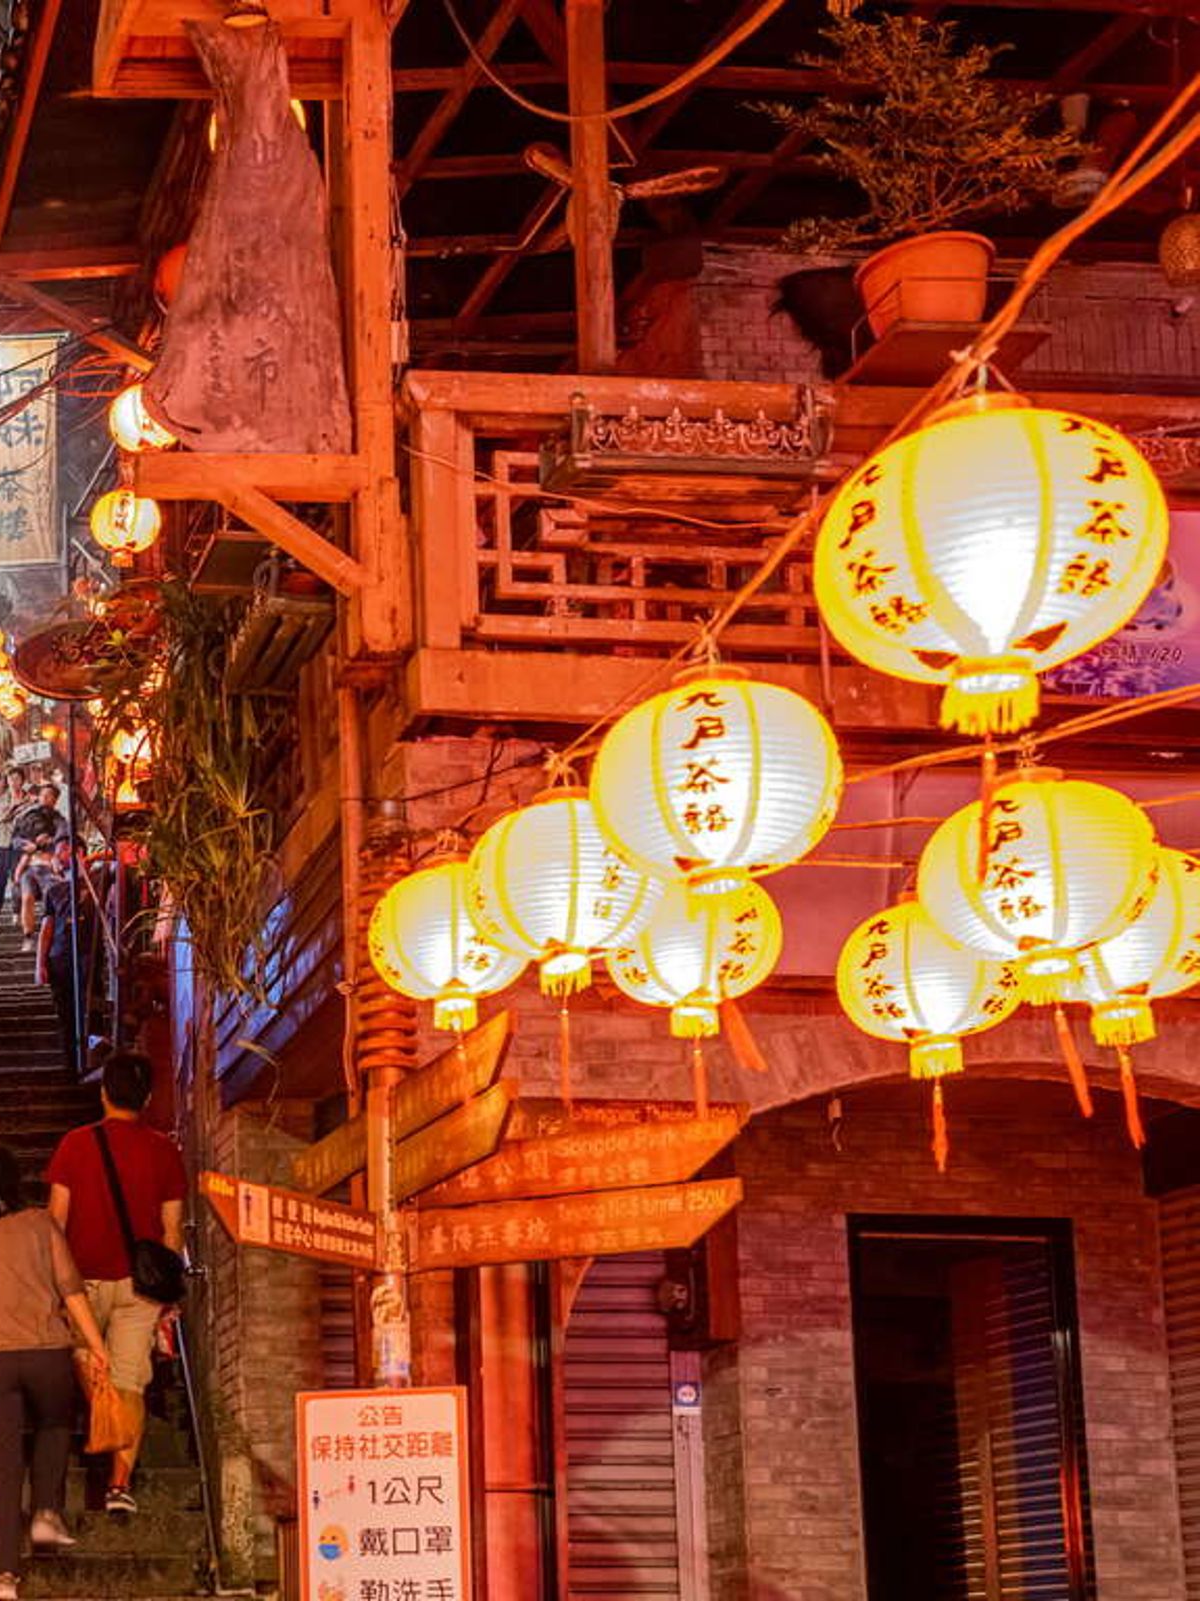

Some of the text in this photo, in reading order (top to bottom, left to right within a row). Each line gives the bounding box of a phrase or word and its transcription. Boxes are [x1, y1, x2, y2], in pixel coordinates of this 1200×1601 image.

[358, 1405, 403, 1428] 公告
[311, 1431, 454, 1463] 保持社交距離
[367, 1475, 445, 1505] 1公尺
[360, 1525, 453, 1557] 戴口罩
